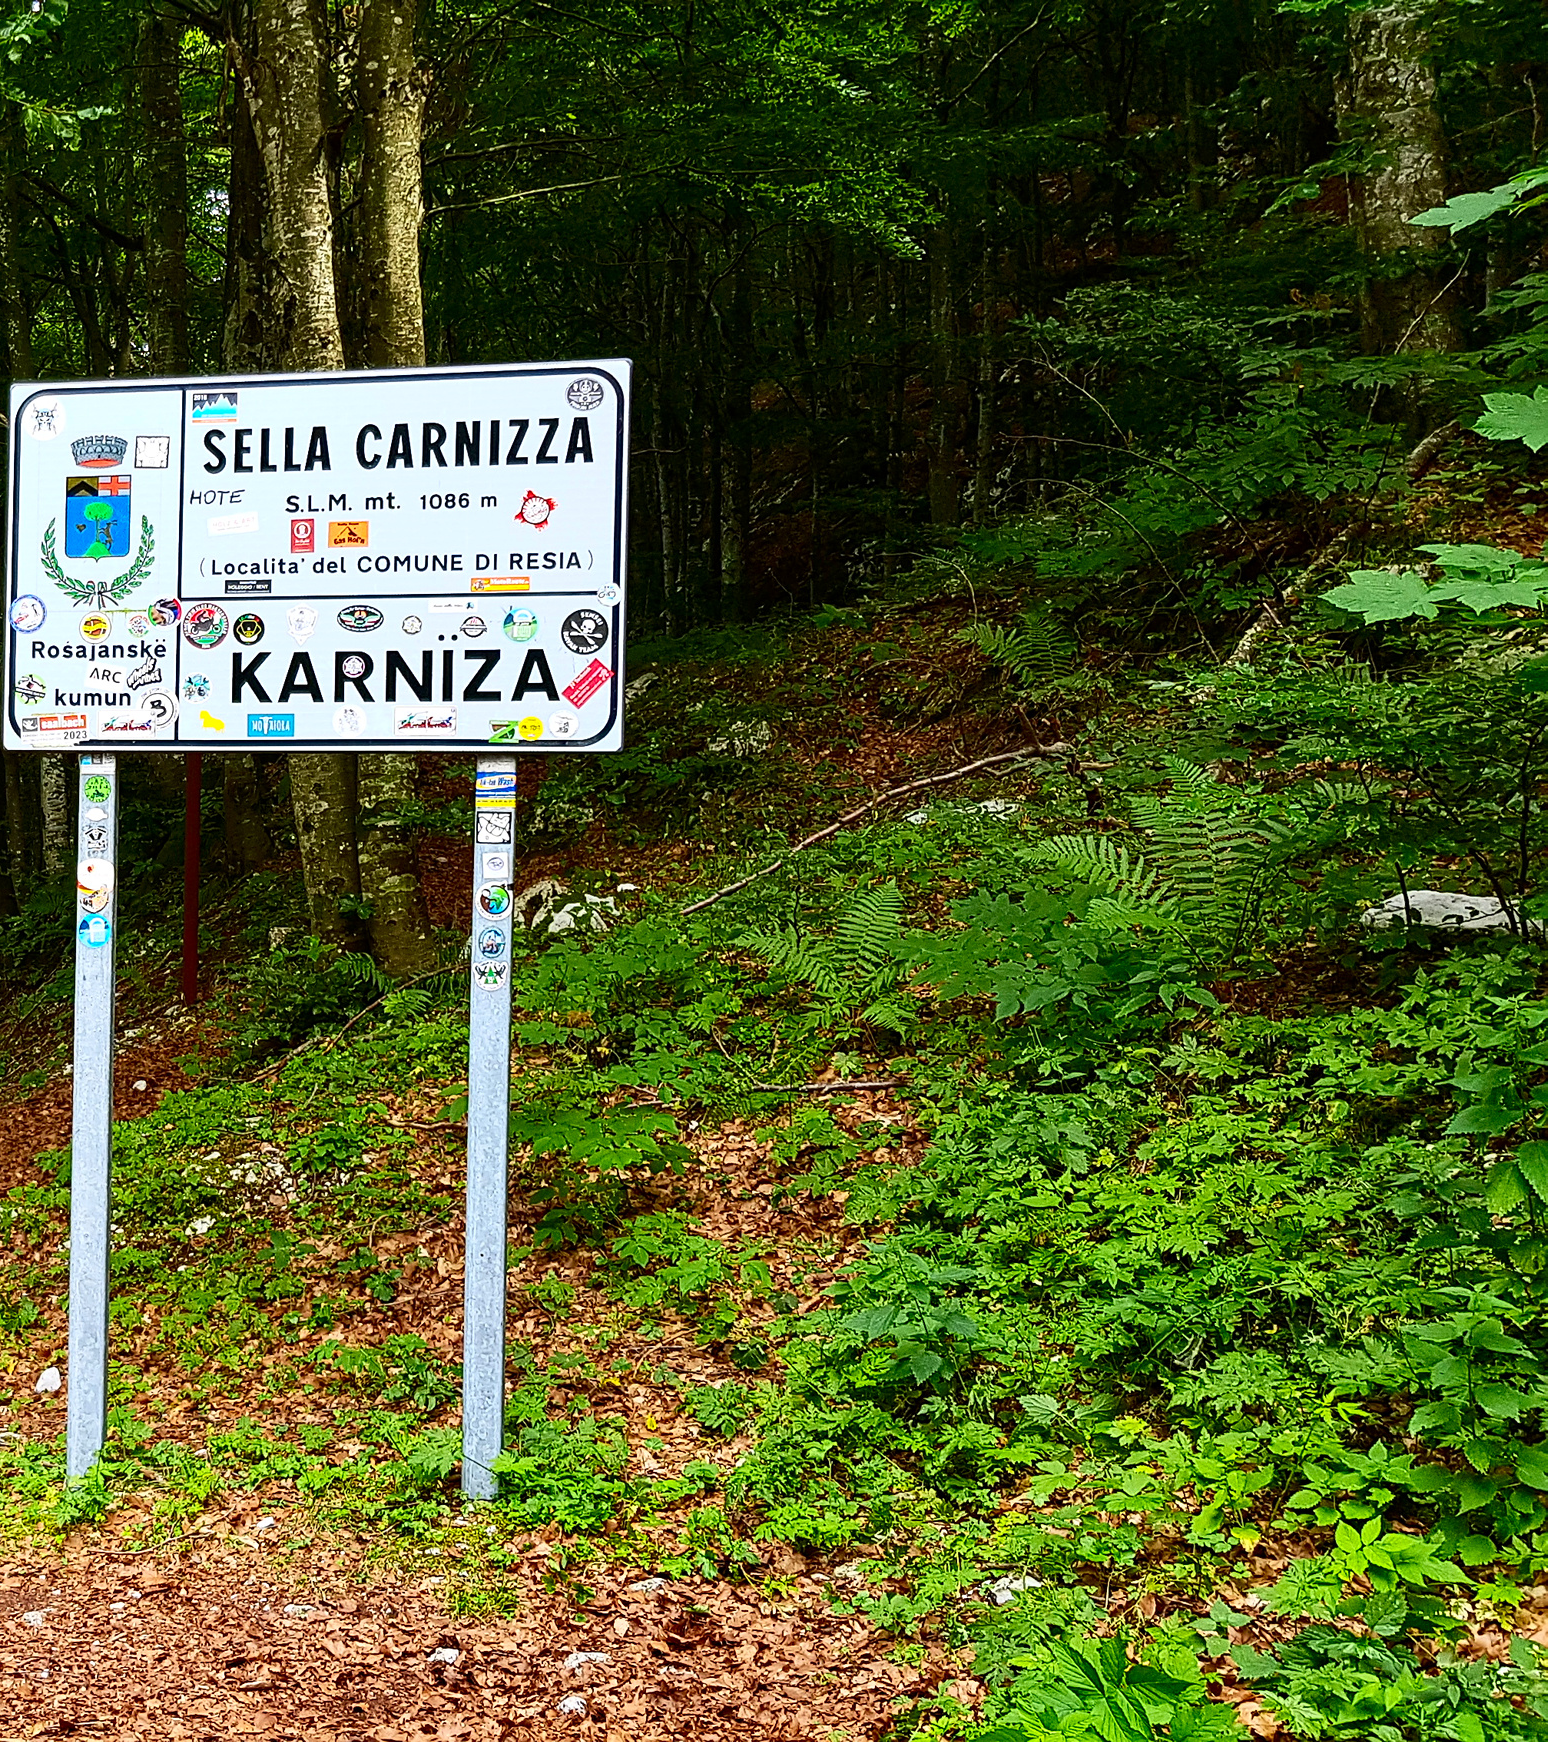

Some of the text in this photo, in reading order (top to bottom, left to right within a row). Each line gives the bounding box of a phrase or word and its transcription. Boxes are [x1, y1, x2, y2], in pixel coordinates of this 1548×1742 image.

[204, 417, 594, 475] SELLA CARNIZZA
[190, 489, 245, 505] HOTE
[286, 492, 497, 513] S.L.M. mt. 1086 m
[313, 556, 347, 573] del
[357, 554, 463, 573] COMUNE
[476, 553, 498, 570] DI
[90, 667, 122, 684] ARC
[231, 634, 561, 704] KARNÏZA
[63, 730, 88, 740] 2023
